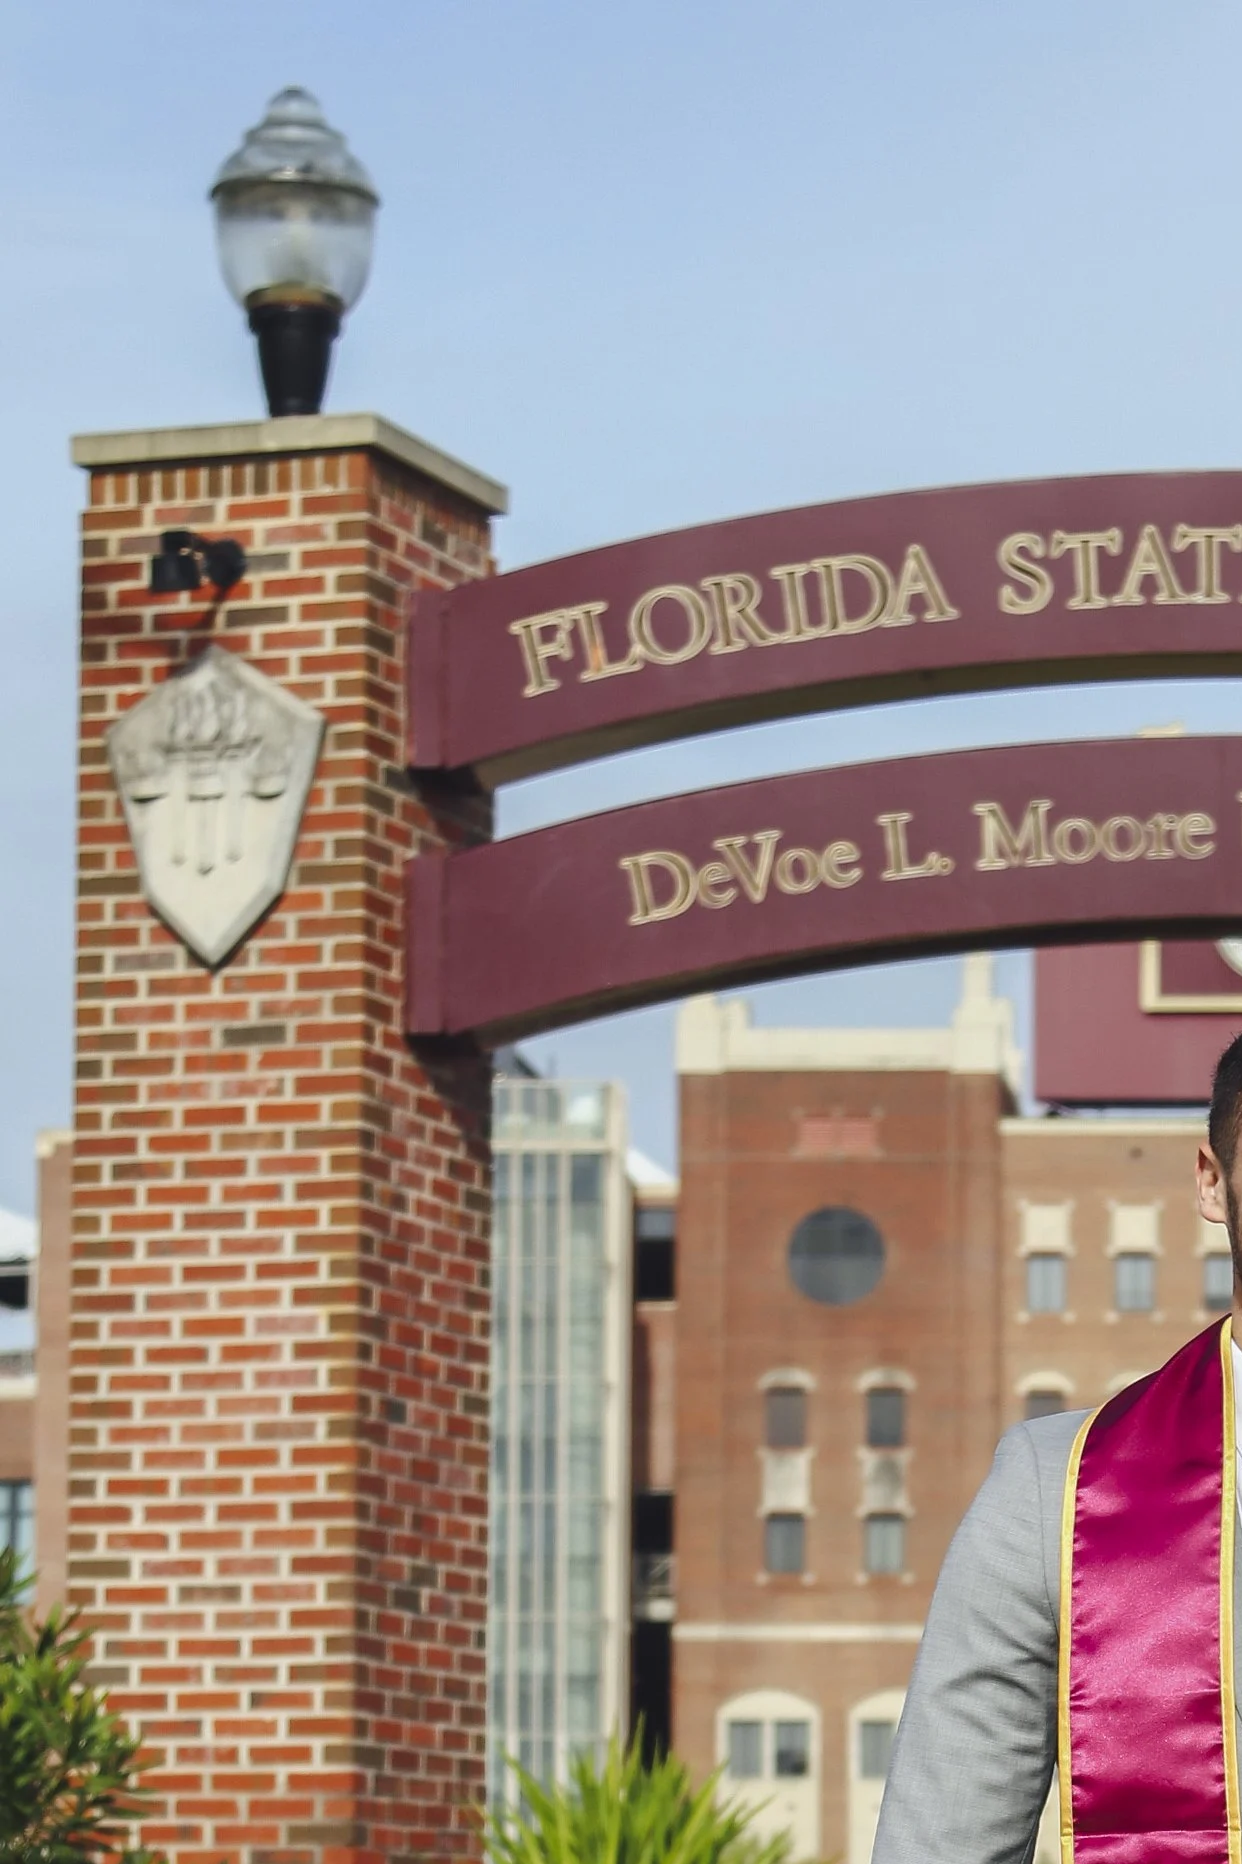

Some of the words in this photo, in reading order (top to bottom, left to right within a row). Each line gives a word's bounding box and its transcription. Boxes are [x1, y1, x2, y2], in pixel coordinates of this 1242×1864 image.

[509, 543, 960, 697] FLORIDA
[620, 829, 862, 926] DeVoe
[877, 812, 955, 882] L.
[973, 799, 1216, 871] Moore
